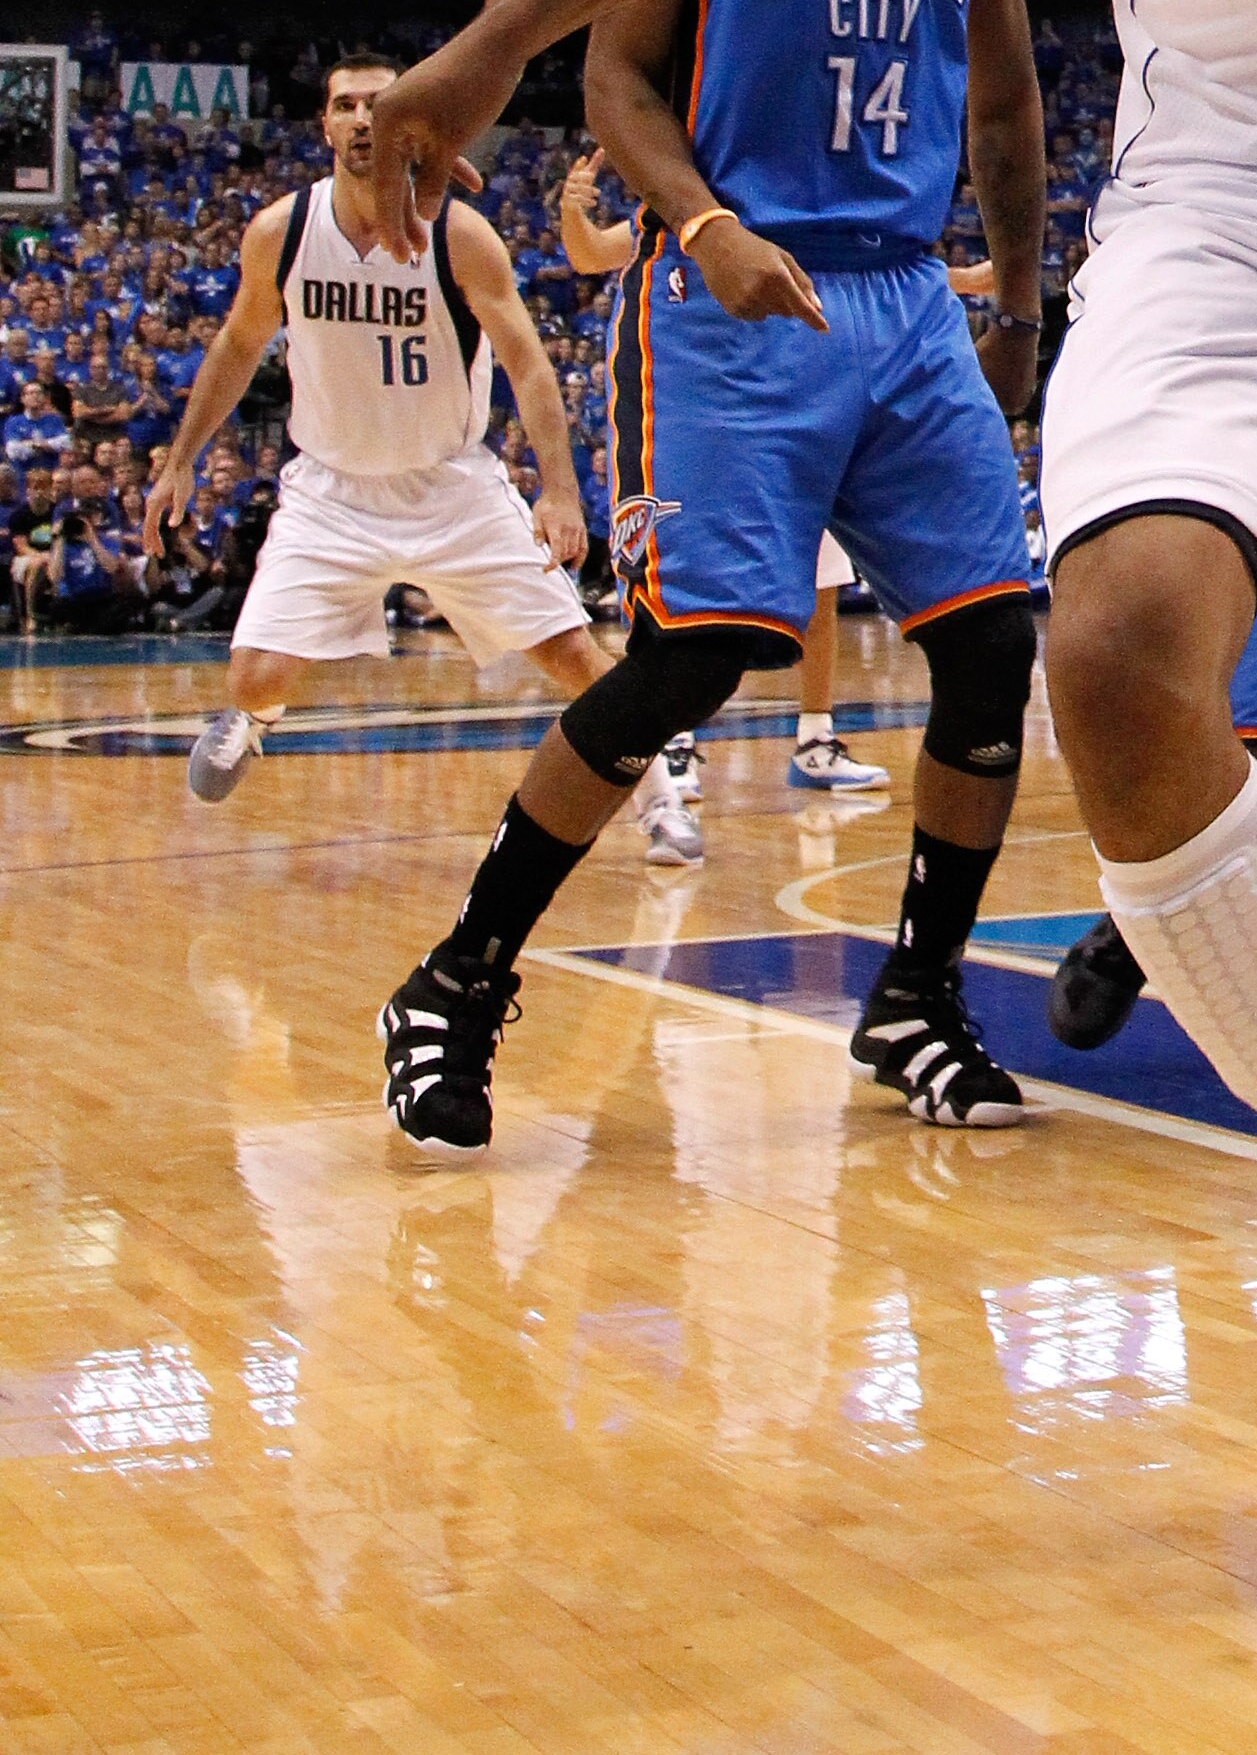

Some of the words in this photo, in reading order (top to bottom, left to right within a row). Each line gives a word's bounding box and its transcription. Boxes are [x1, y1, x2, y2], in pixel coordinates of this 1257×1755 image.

[828, 56, 908, 156] 14
[303, 280, 427, 327] DALLAS
[378, 335, 429, 386] 16
